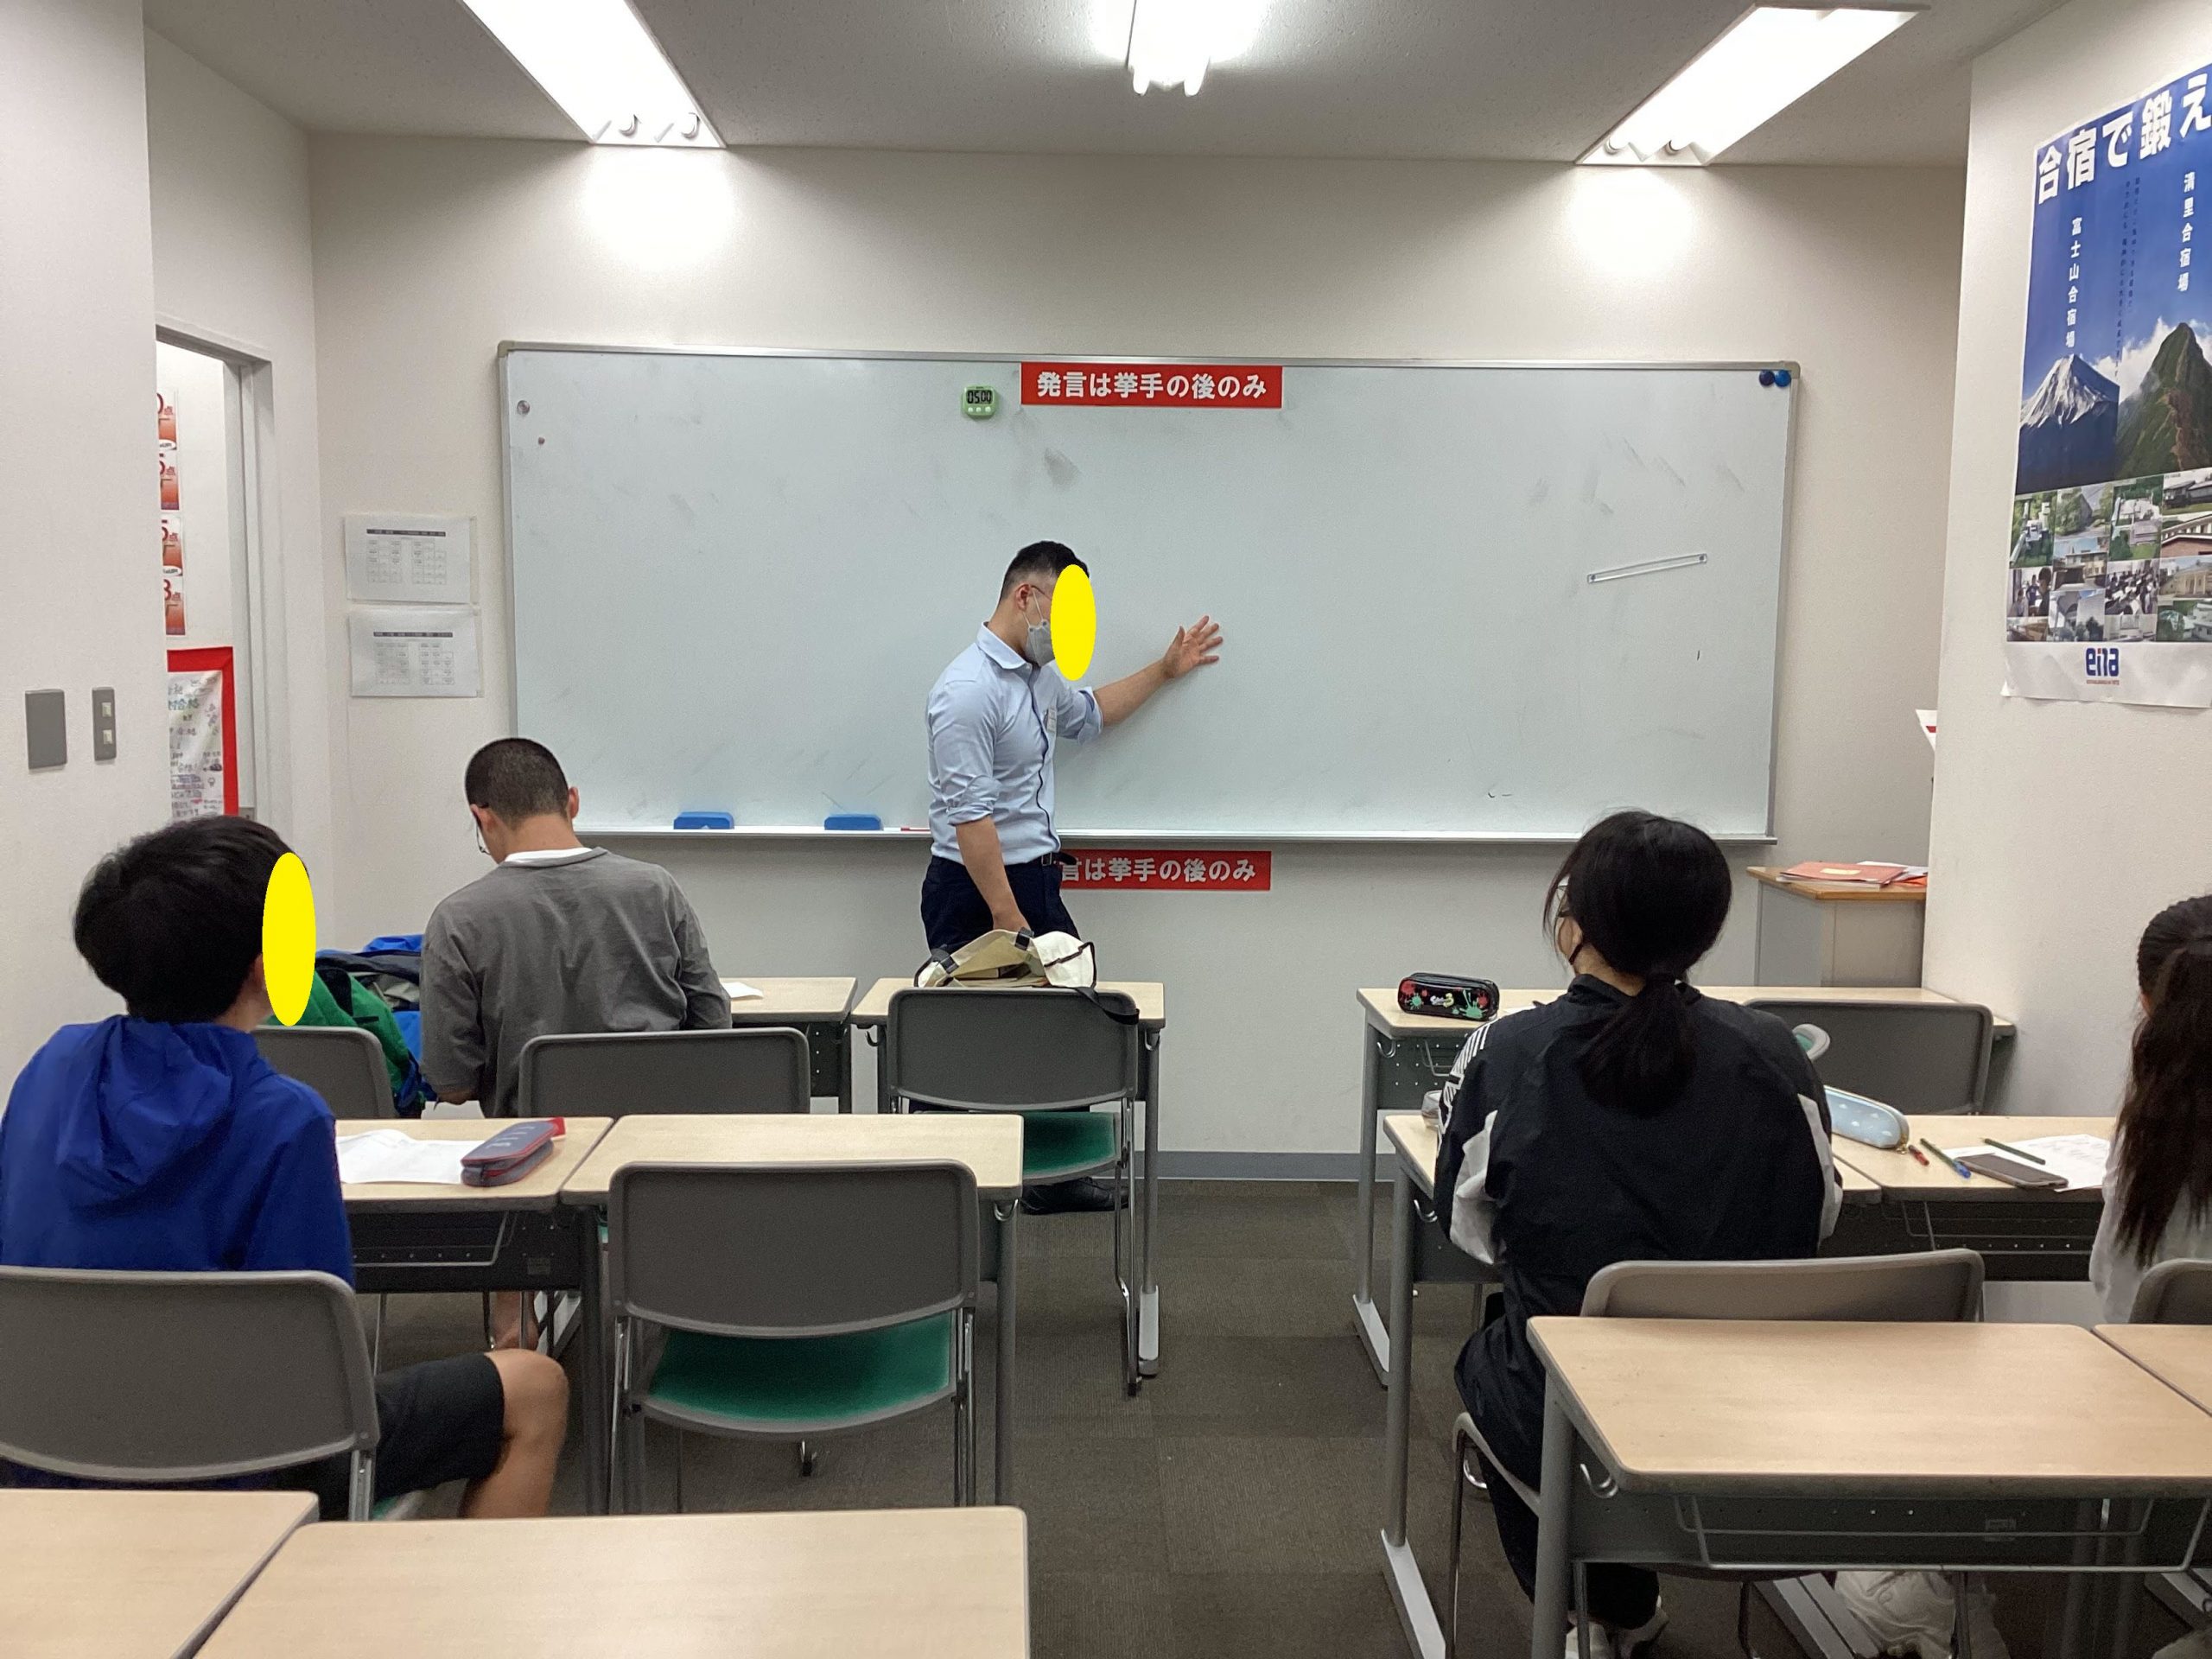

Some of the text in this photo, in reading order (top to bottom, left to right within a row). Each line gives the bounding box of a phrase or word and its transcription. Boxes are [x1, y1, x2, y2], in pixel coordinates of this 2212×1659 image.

[2037, 73, 2212, 205] 合宿で鍛え
[2066, 217, 2082, 348] 富士山合宿場
[2177, 171, 2196, 292] 清里合宿場
[1037, 371, 1267, 399] 発言は挙手の後のみ
[1054, 856, 1255, 883] 言は挙手の後のみ
